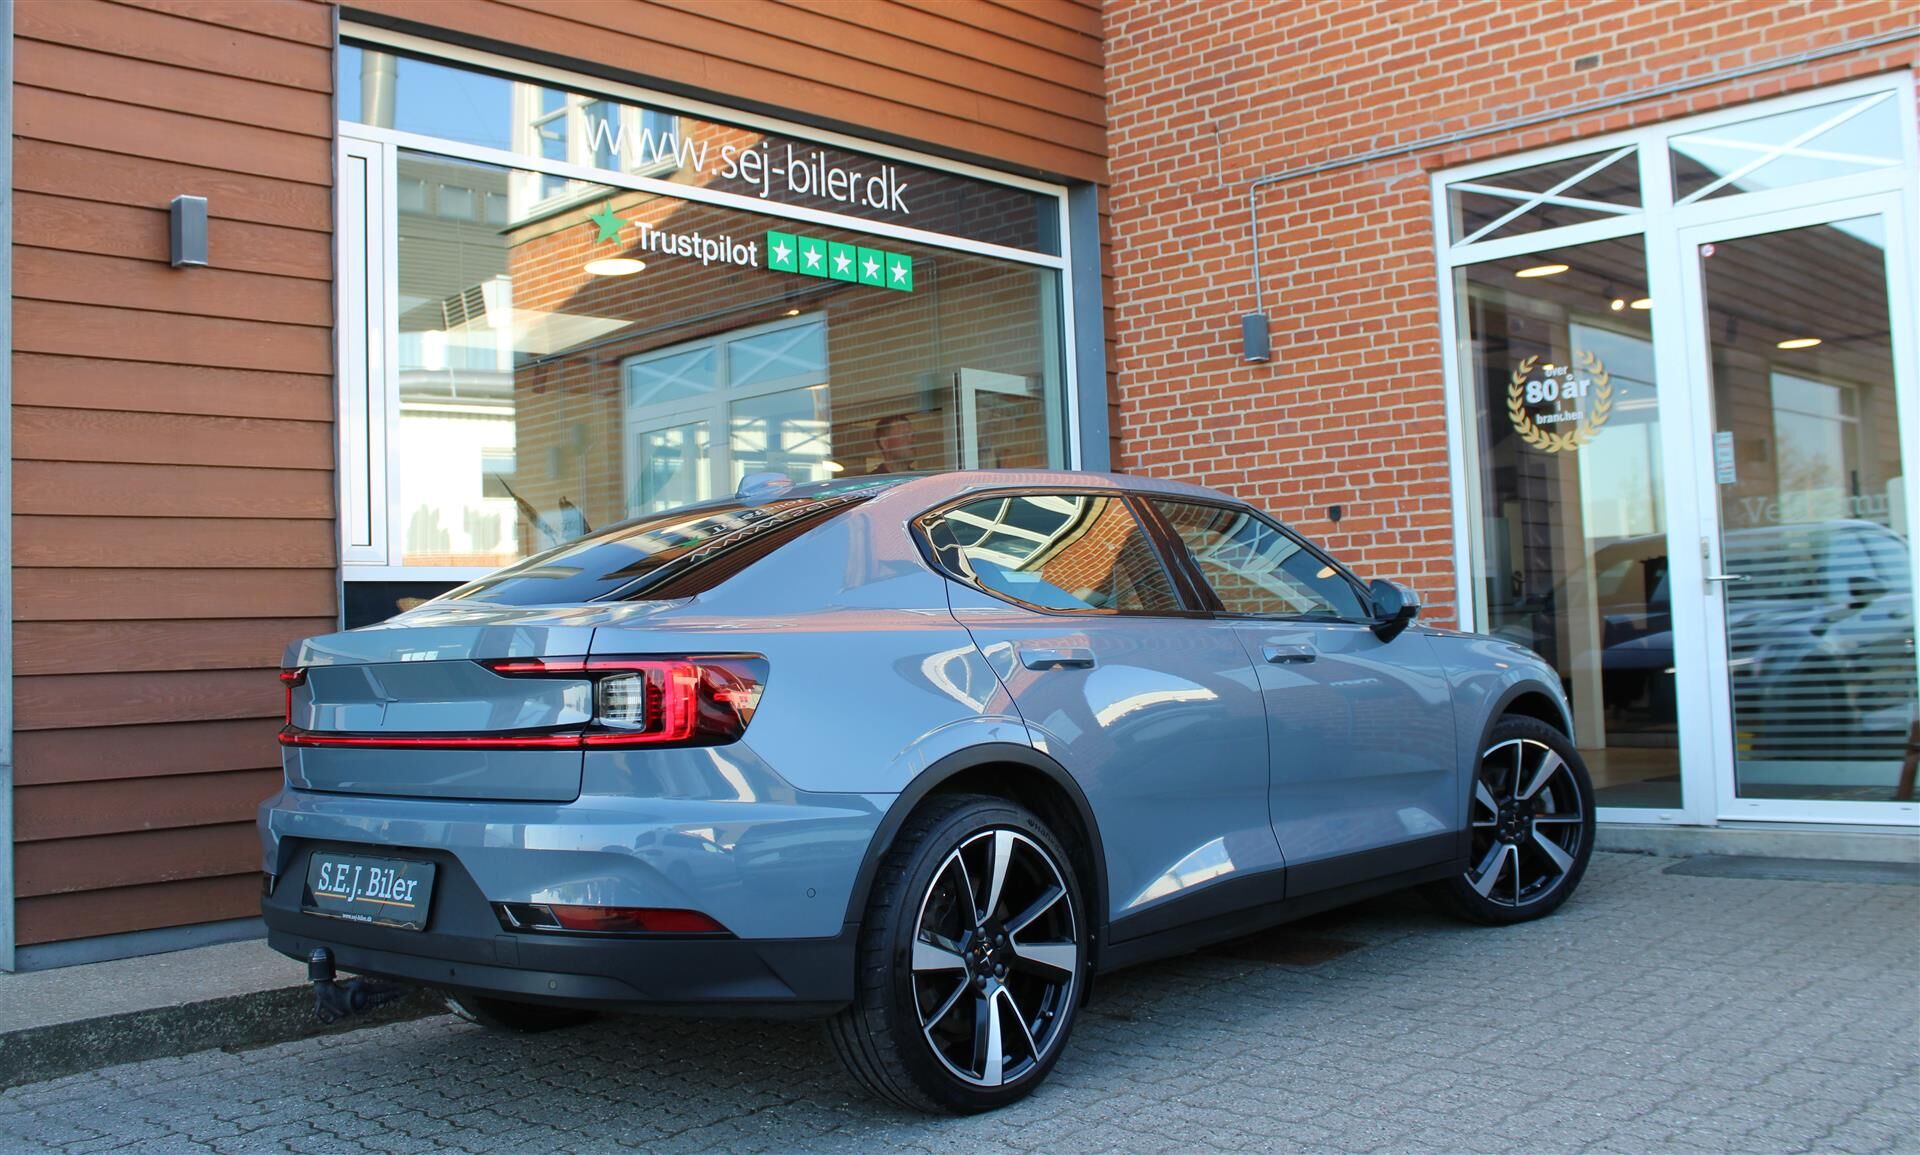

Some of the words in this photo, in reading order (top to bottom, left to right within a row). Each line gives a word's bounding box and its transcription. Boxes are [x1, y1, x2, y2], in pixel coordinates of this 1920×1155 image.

[584, 114, 910, 214] www.sej-biler.dk
[634, 221, 758, 268] Trustpilot
[1526, 378, 1559, 404] 80
[1562, 373, 1591, 399] år
[1544, 366, 1569, 378] over
[1536, 410, 1584, 425] branchen
[318, 862, 362, 902] S.E.J.
[366, 867, 418, 902] Biler
